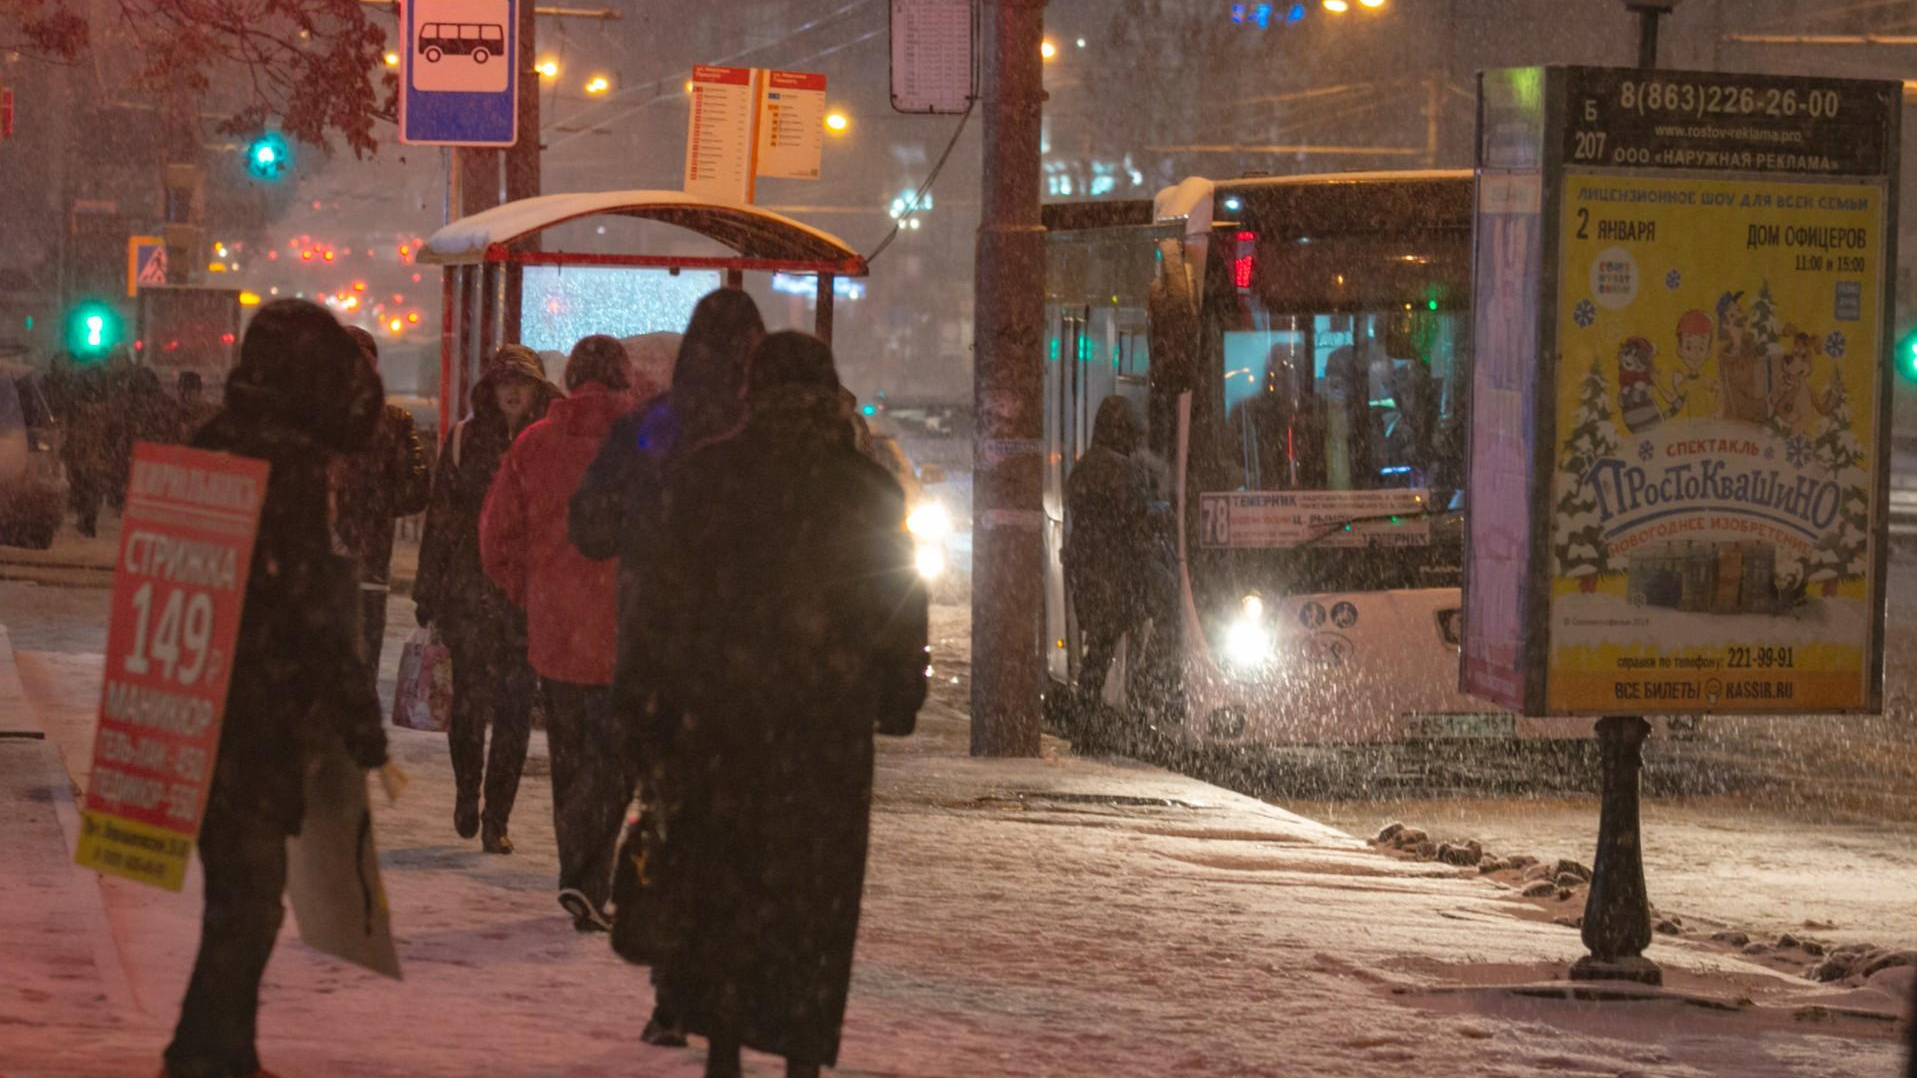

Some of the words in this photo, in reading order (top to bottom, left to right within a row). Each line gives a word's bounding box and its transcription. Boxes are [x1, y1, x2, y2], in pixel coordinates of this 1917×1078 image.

[1584, 100, 1598, 121] Б
[1620, 81, 1839, 118] 8(863)226-26-00
[1574, 131, 1607, 160] 207
[1655, 125, 1802, 143] www.rostov-reklama.pro
[1614, 147, 1650, 163] ООО
[1655, 149, 1752, 168] «НАРУЖНАЯ
[1756, 153, 1839, 170] РЕКЛАМА»
[1701, 192, 1735, 206] ШОУ
[1740, 194, 1772, 208] ДЛЯ
[1576, 207, 1590, 240] 2
[1597, 219, 1656, 241] ЯНВАРЯ
[1747, 223, 1780, 247] ДОМ
[1784, 225, 1867, 251] ОФИЦЕРОВ
[1795, 255, 1823, 272] 11:00
[1837, 256, 1866, 273] 15:00
[1666, 438, 1760, 457] СПЕКТАКЛЬ
[1203, 498, 1230, 545] 78
[1607, 517, 1706, 557] НОВОГОДНЕЕ
[1710, 517, 1811, 553] ИЗОБРЕТЕНИЕ
[124, 530, 238, 589] СТРИЖКА
[123, 582, 214, 685] 149
[1658, 658, 1672, 668] по
[1727, 647, 1794, 668] 221-99-91
[1615, 681, 1640, 699] ВСЕ
[1644, 681, 1700, 700] БИЛЕТЫ
[1725, 681, 1793, 699] KASSIR.RU
